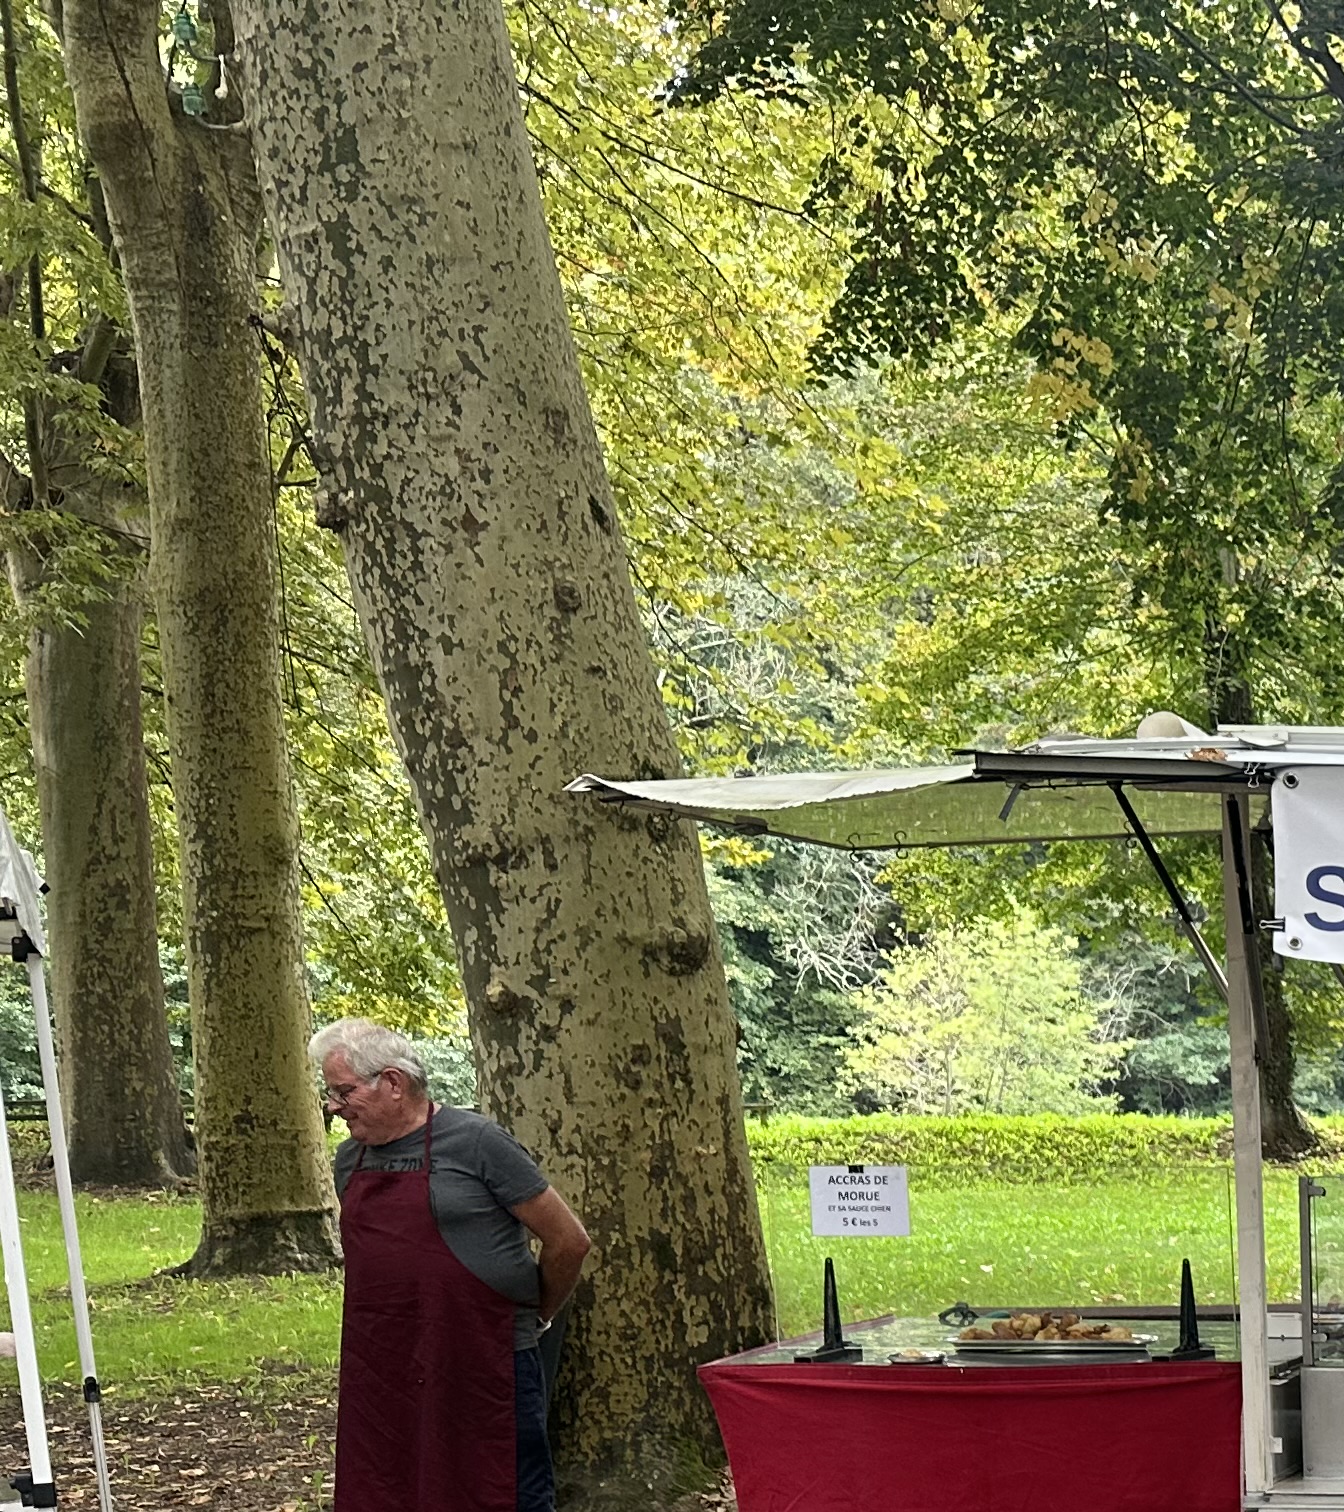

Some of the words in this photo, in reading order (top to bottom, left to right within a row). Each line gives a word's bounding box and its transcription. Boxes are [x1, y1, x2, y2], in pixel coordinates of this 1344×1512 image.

[828, 1175, 871, 1186] ACCRAS
[874, 1175, 889, 1186] DE
[838, 1191, 880, 1201] MORUE
[842, 1217, 849, 1227] 5
[851, 1217, 858, 1227] €
[859, 1218, 872, 1227] les
[872, 1218, 879, 1227] 5
